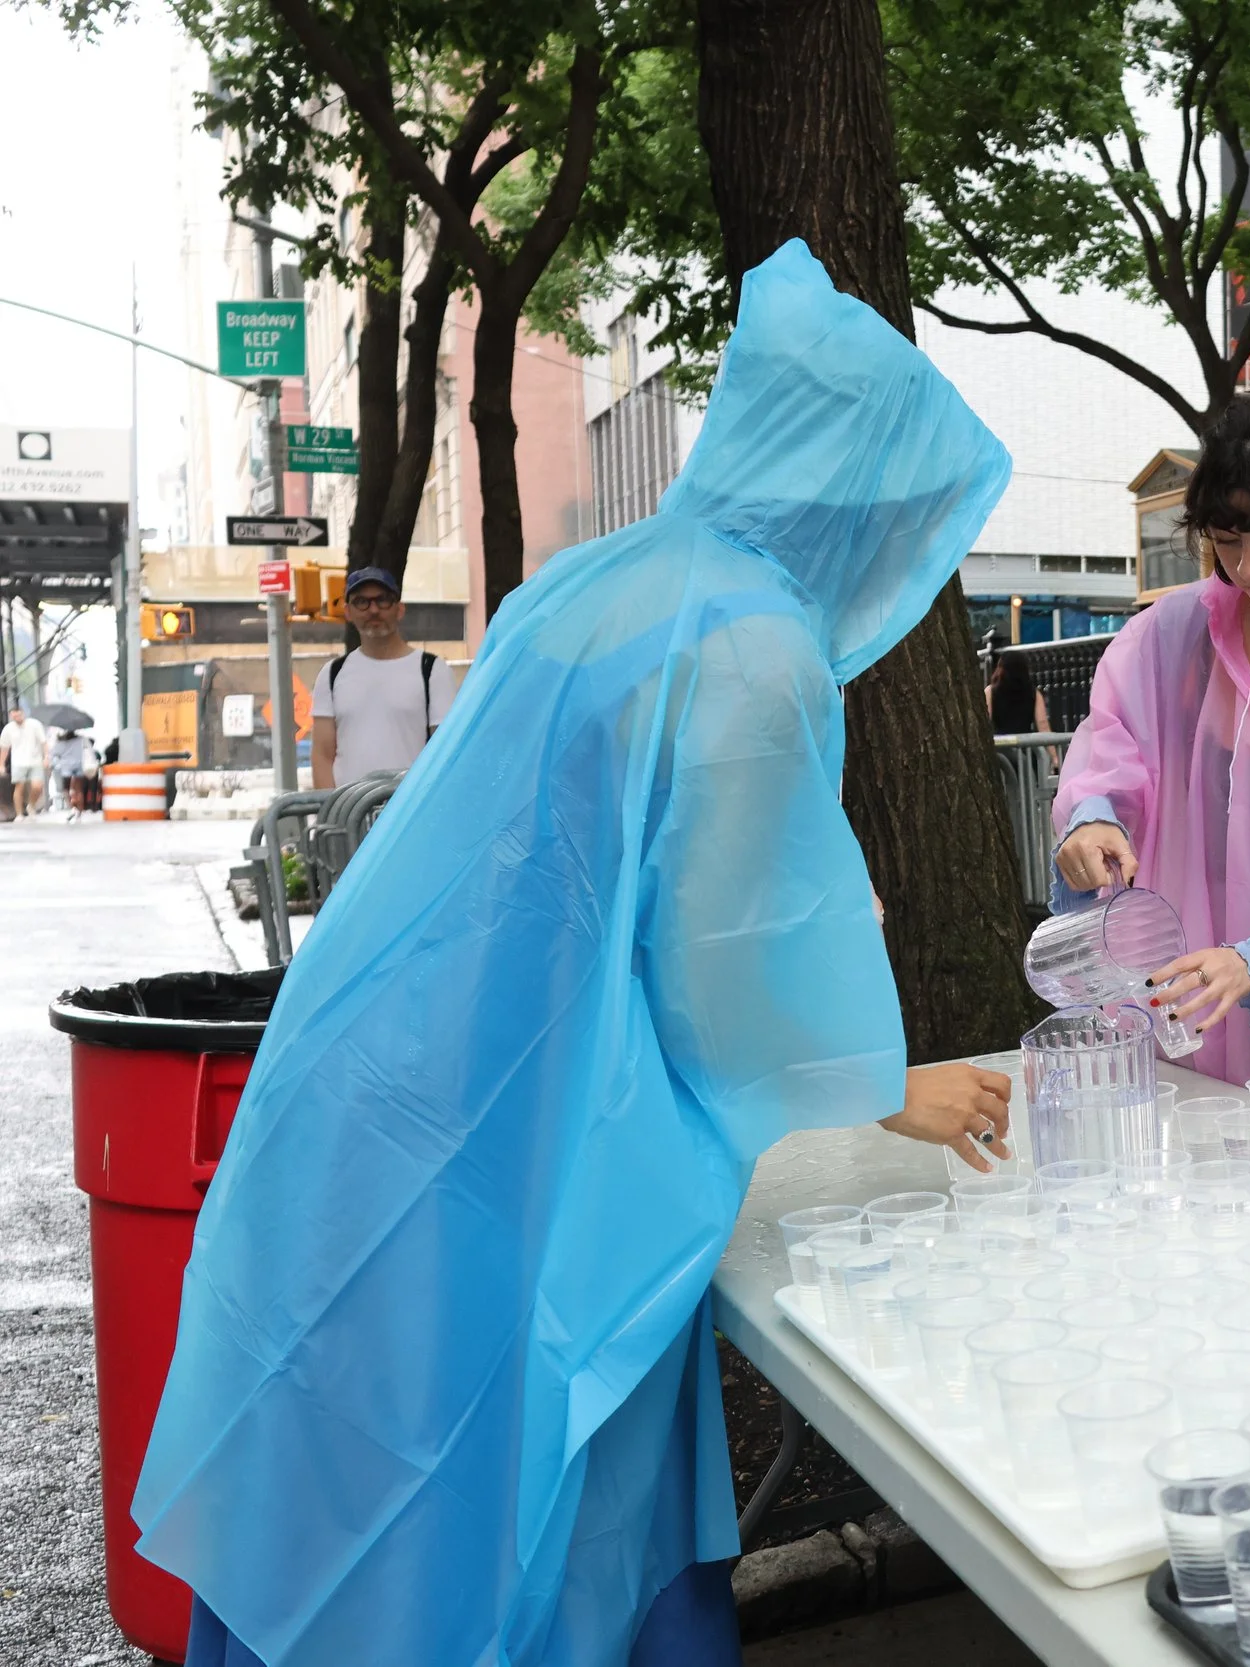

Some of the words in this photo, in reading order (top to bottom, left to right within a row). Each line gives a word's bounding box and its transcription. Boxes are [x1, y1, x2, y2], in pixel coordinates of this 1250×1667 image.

[226, 311, 297, 330] Broadway
[243, 331, 280, 347] KEEP
[245, 351, 279, 367] LEFT
[294, 427, 306, 445] W
[312, 429, 330, 446] 29
[237, 525, 264, 537] ONE
[284, 525, 312, 537] WAY
